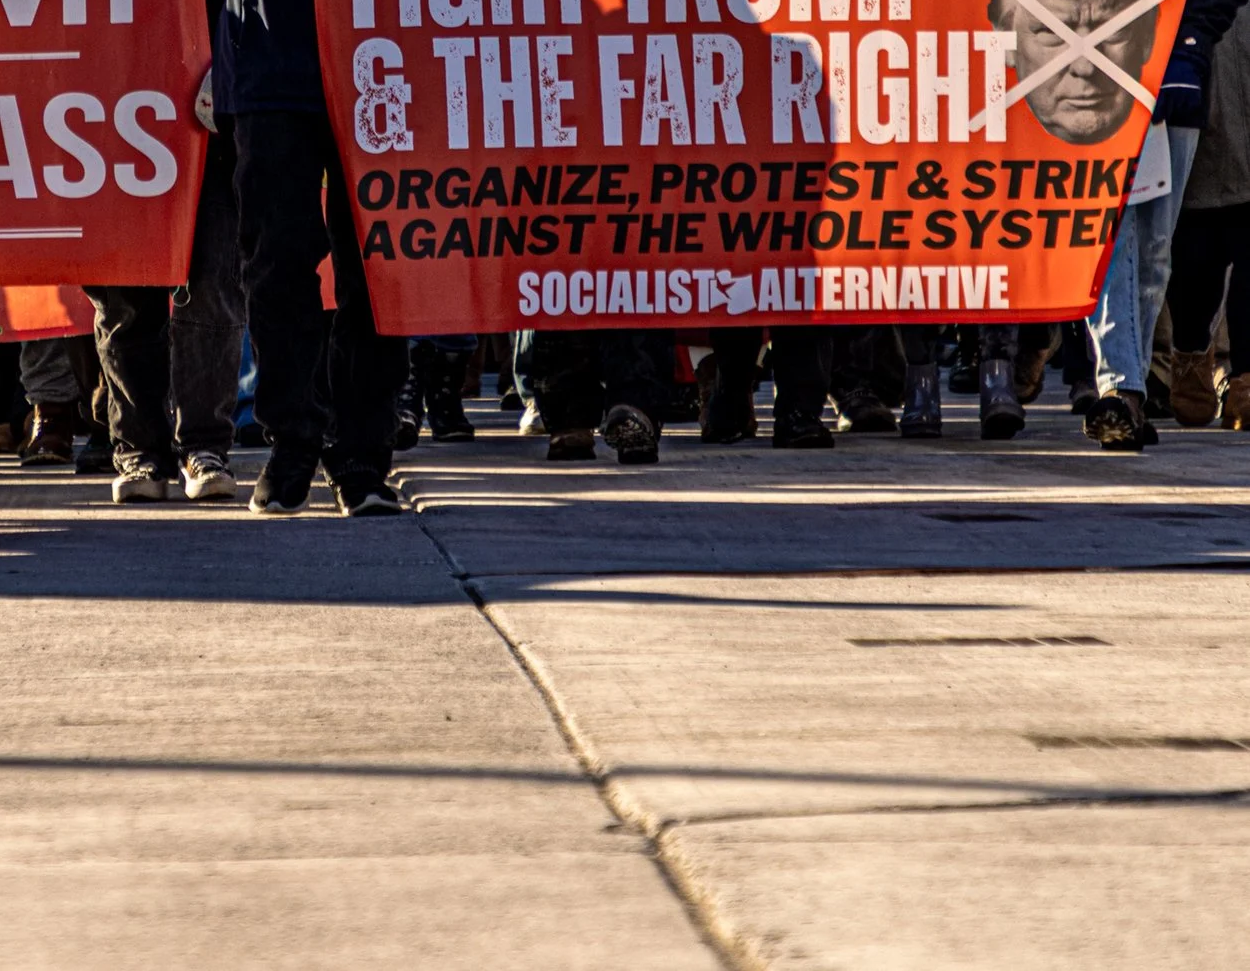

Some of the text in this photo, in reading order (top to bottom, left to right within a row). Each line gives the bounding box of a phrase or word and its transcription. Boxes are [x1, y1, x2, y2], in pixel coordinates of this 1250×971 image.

[353, 29, 1017, 155] & THE FAR RIGHT
[357, 163, 640, 212] ORGANIZE,
[650, 160, 898, 204] PROTEST
[907, 159, 949, 202] &
[362, 214, 596, 260] AGAINST
[606, 212, 706, 255] THE
[718, 209, 913, 253] WHOLE
[518, 264, 1010, 316] SOCIALIST ALTERNATIVE
